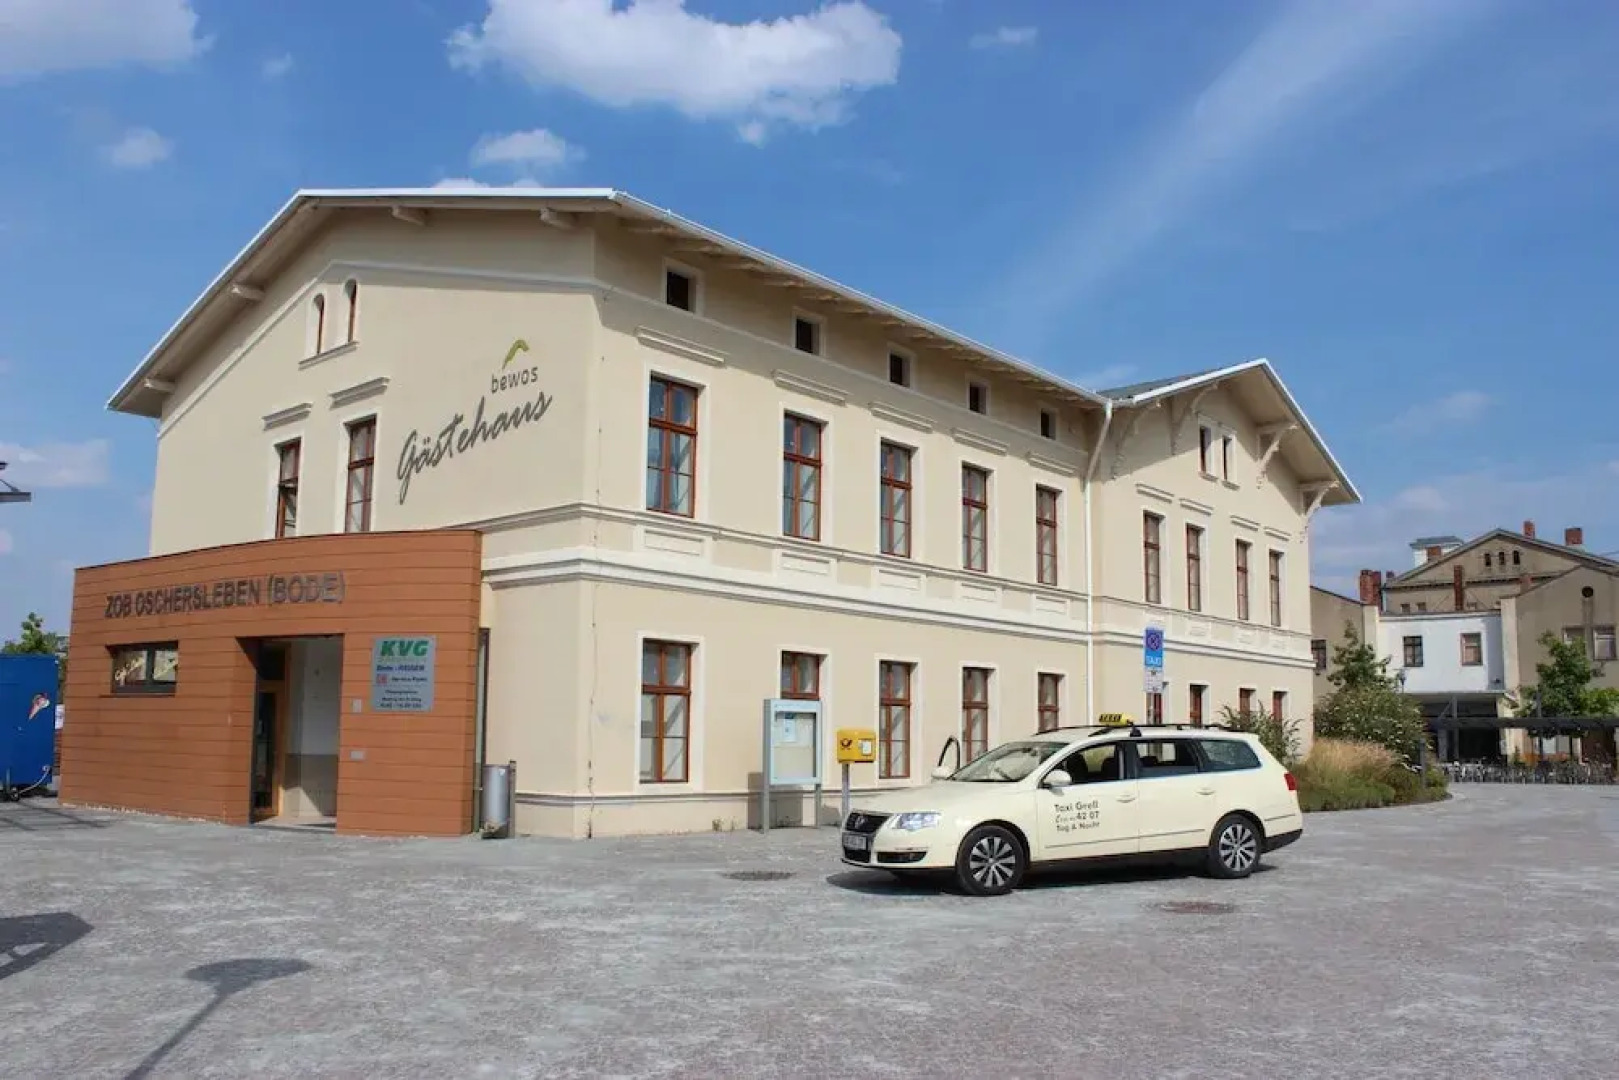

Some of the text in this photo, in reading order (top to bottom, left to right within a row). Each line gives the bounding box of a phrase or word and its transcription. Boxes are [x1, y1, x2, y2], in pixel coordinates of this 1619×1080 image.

[491, 366, 538, 394] bewos
[397, 391, 553, 505] Gästehaus
[104, 570, 346, 619] ZOB OSCHERSLEBEN (BODE)
[381, 640, 430, 657] KVG
